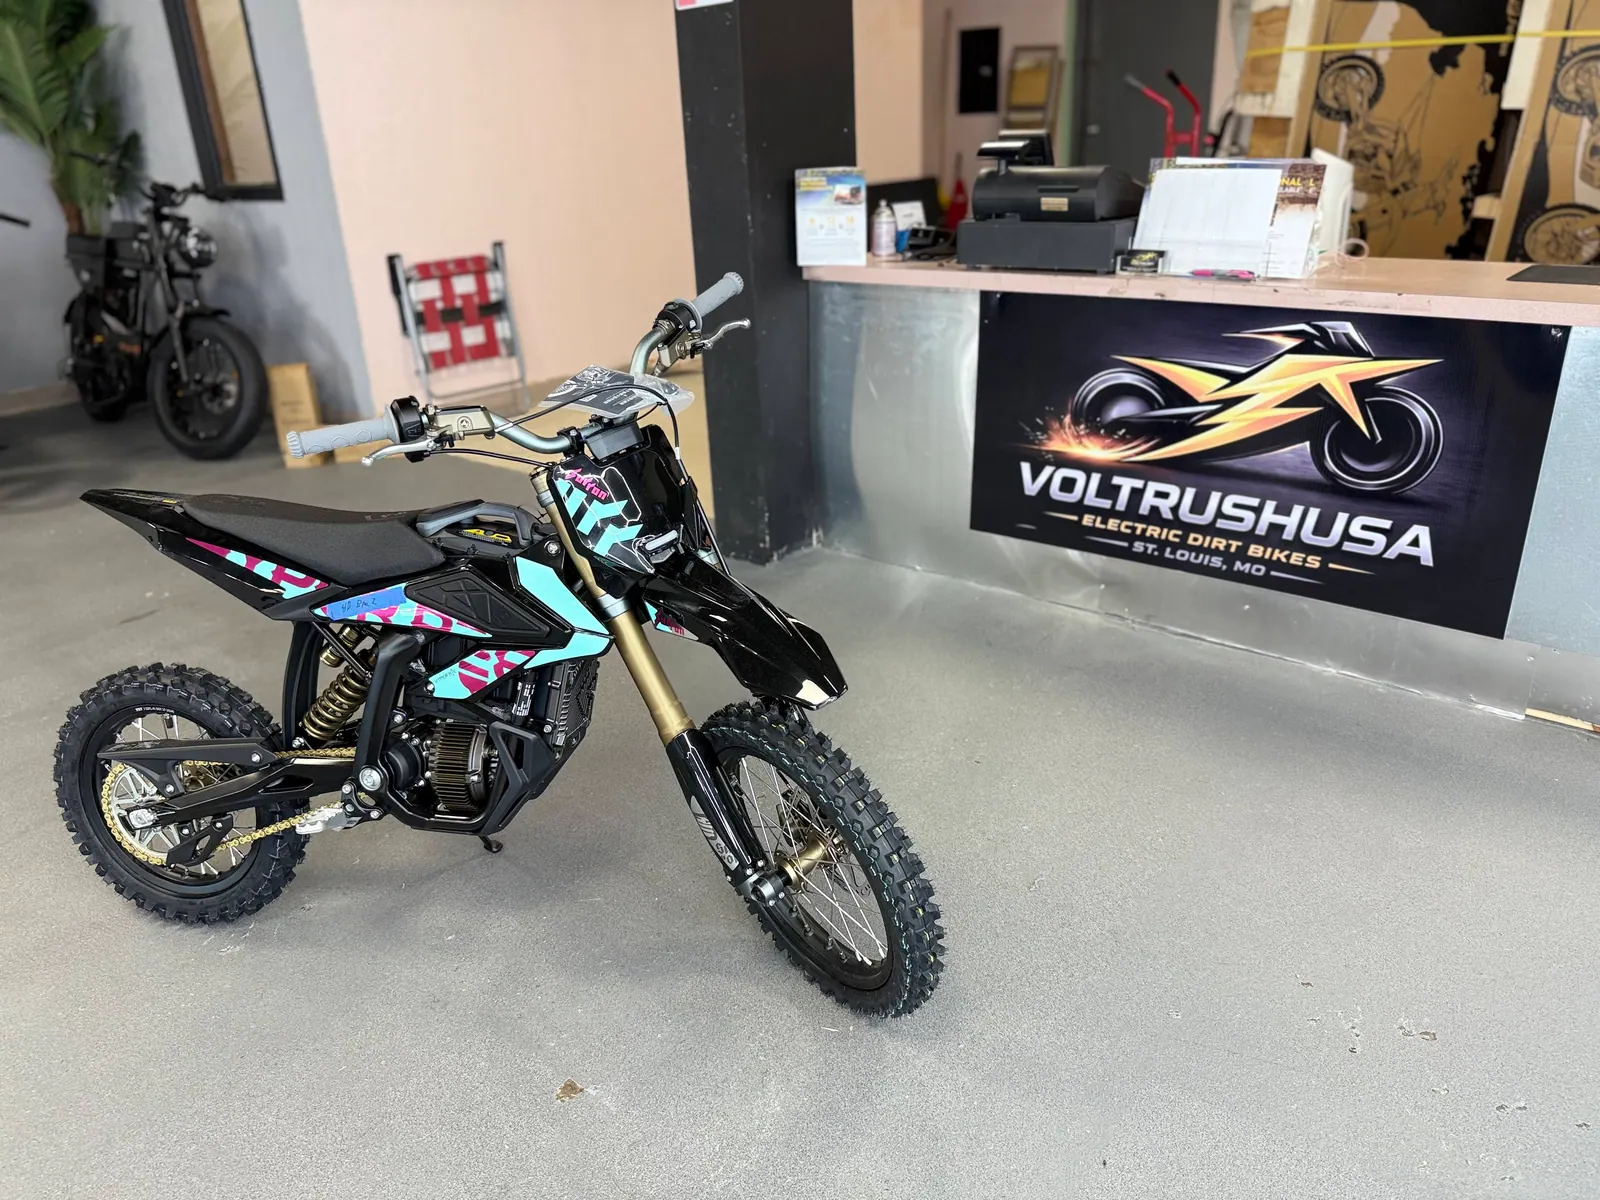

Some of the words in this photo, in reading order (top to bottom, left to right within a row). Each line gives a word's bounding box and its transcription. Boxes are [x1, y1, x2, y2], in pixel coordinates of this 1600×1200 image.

[1020, 461, 1434, 567] VOLTRUSHUSA
[1081, 513, 1183, 542] ELECTRIC
[1187, 533, 1242, 553] DIRT
[1247, 543, 1323, 569] BIKES
[1132, 541, 1159, 556] ST.
[1164, 547, 1228, 571] LOUIS,
[1232, 560, 1266, 576] MO
